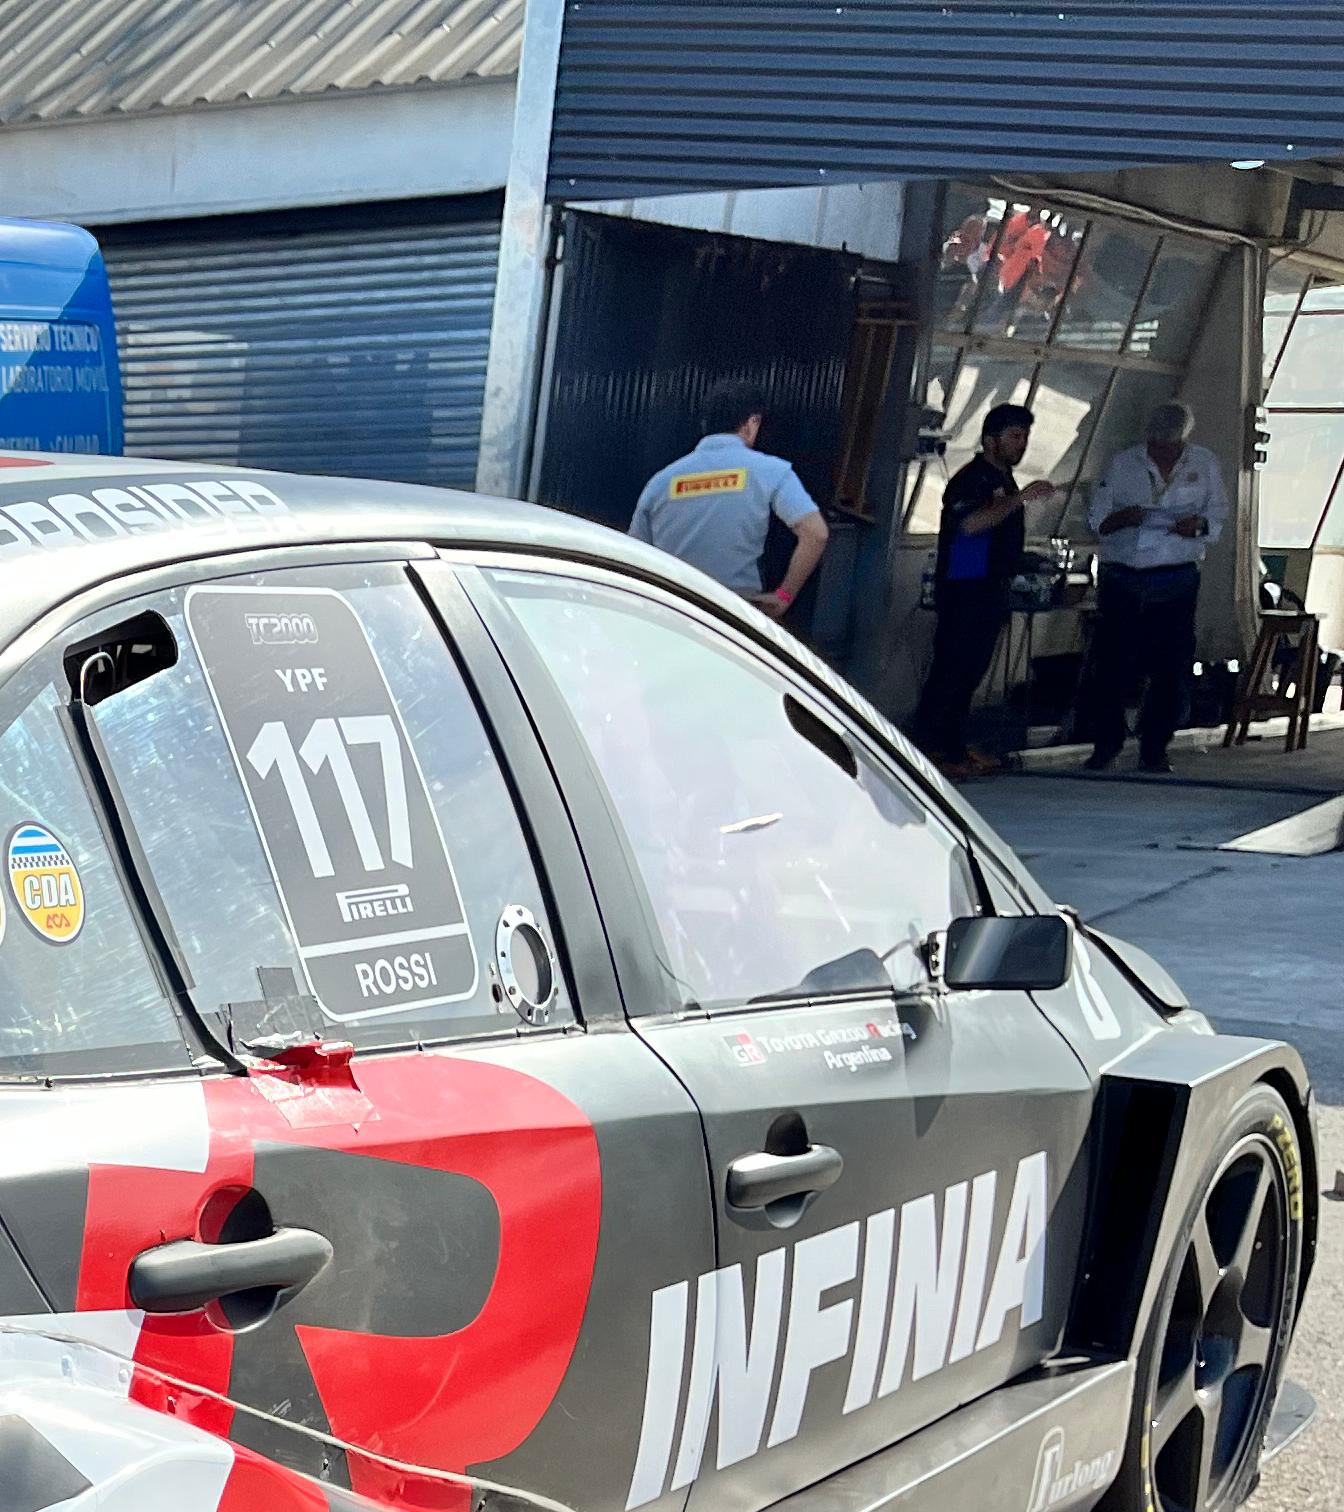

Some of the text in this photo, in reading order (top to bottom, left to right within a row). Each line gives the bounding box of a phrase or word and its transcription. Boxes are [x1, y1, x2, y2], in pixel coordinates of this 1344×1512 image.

[2, 365, 73, 394] LABORATORIO
[246, 613, 318, 643] TC2000
[275, 668, 328, 693] YPF
[246, 714, 413, 878] 117
[23, 873, 78, 910] CDA
[335, 884, 414, 923] PIRELLI
[355, 953, 438, 997] ROSSI
[824, 1045, 893, 1072] Argentina
[626, 1150, 1049, 1511] INFINIA
